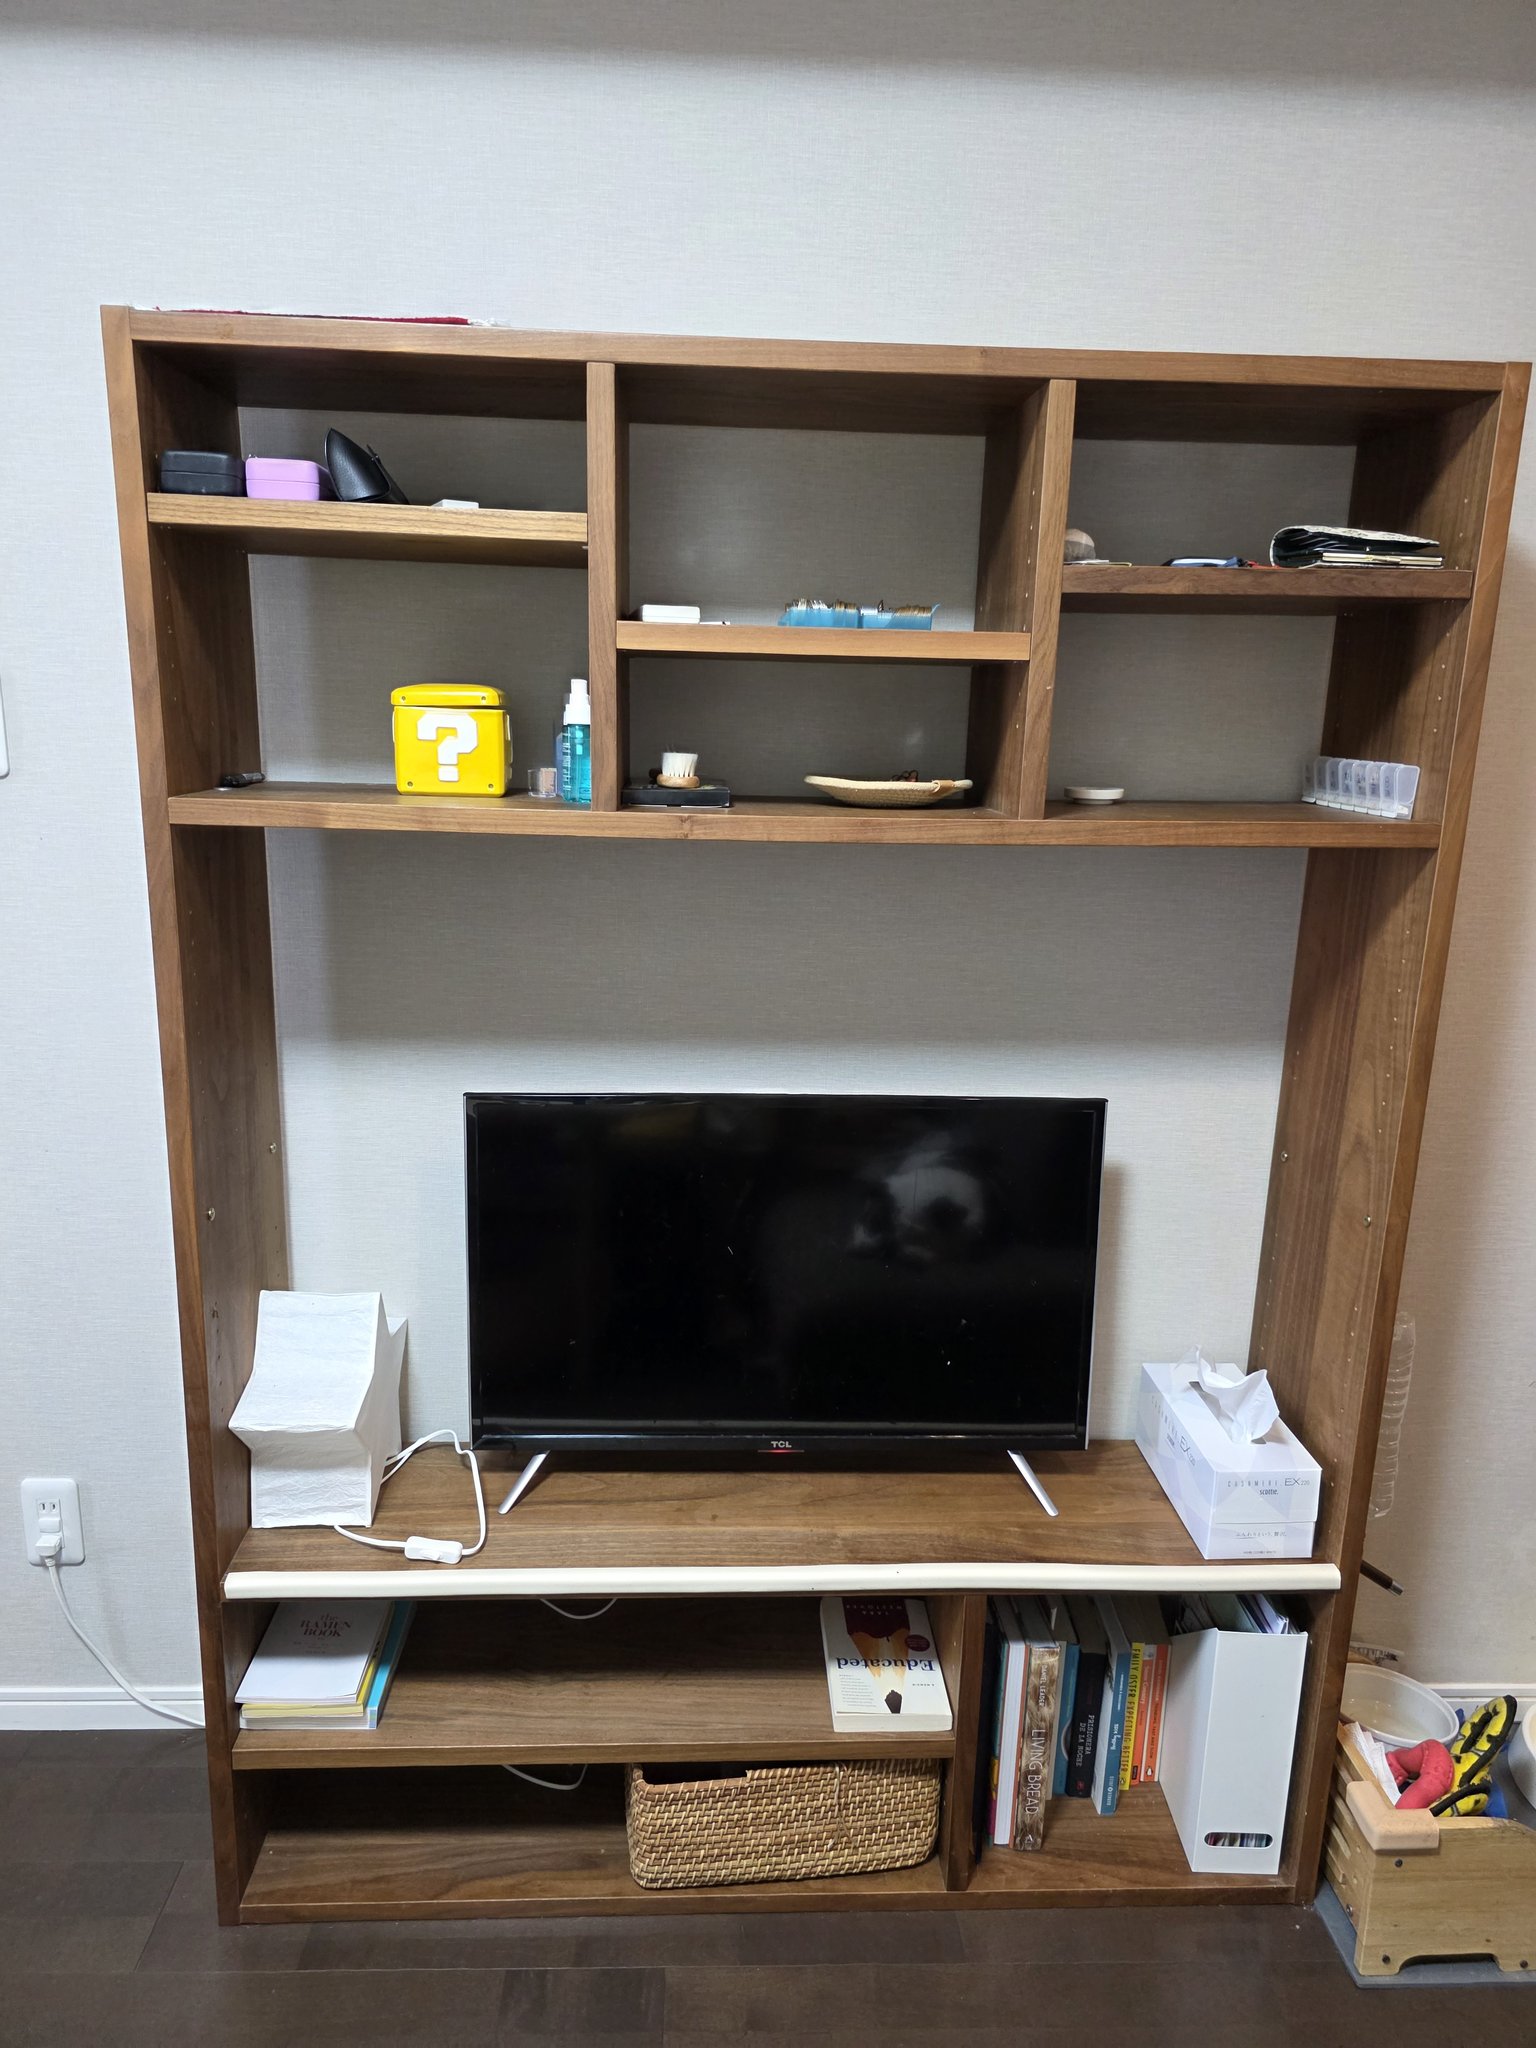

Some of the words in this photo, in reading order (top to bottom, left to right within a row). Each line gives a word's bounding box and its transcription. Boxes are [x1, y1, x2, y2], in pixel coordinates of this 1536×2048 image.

[770, 1440, 792, 1449] TCL
[303, 1628, 342, 1637] BOOK
[836, 1657, 936, 1671] Educated
[1131, 1648, 1141, 1672] EMILY
[1039, 1664, 1048, 1684] DANIEL
[1127, 1674, 1138, 1698] OSTER
[1038, 1685, 1046, 1707] LEADER
[1123, 1700, 1136, 1743] EXPECTING
[1029, 1729, 1046, 1770] LIVING
[1121, 1745, 1131, 1773] BETTER
[1024, 1774, 1042, 1815] BREAD
